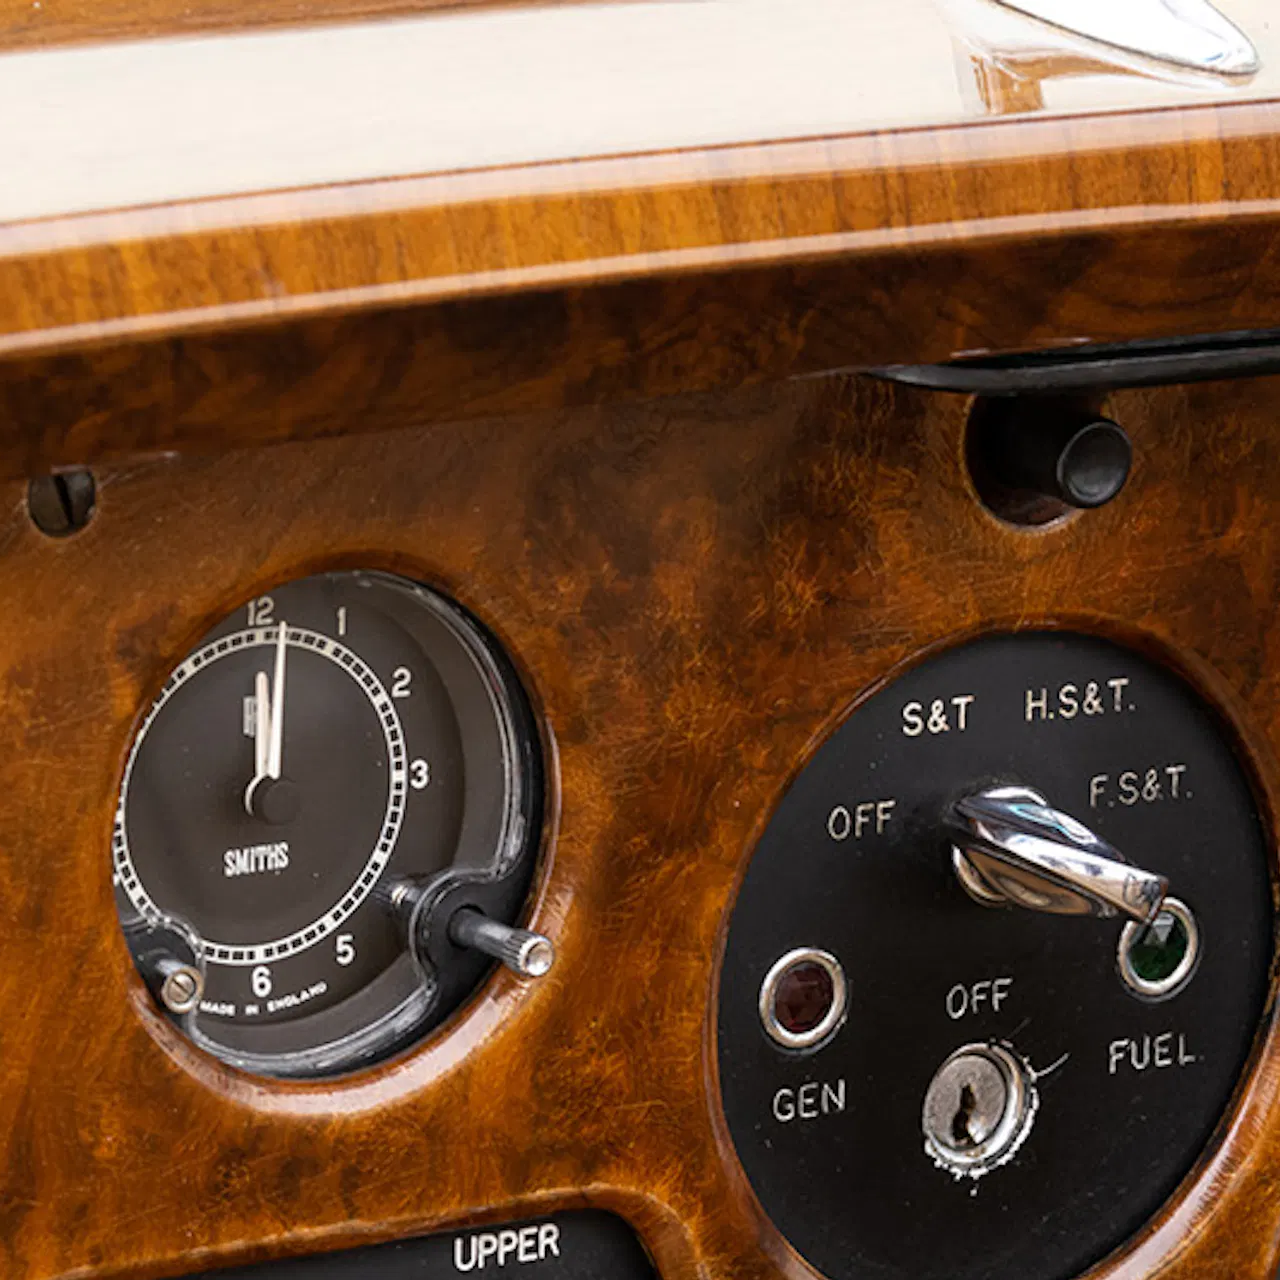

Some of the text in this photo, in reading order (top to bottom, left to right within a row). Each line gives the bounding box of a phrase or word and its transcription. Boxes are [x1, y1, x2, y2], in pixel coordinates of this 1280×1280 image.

[247, 596, 274, 626] 12
[336, 606, 347, 636] 1
[391, 666, 412, 698] 2
[901, 696, 973, 736] S&T
[409, 759, 430, 790] 3
[827, 801, 897, 841] OFF
[223, 841, 289, 877] SMITHS
[334, 934, 355, 965] 5
[199, 981, 328, 1016] MADE IN ENGLAND
[251, 965, 272, 998] 6
[946, 978, 1013, 1020] OFF
[1108, 1033, 1197, 1074] FUEL
[772, 1080, 847, 1123] GEN
[453, 1223, 561, 1273] UPPER
